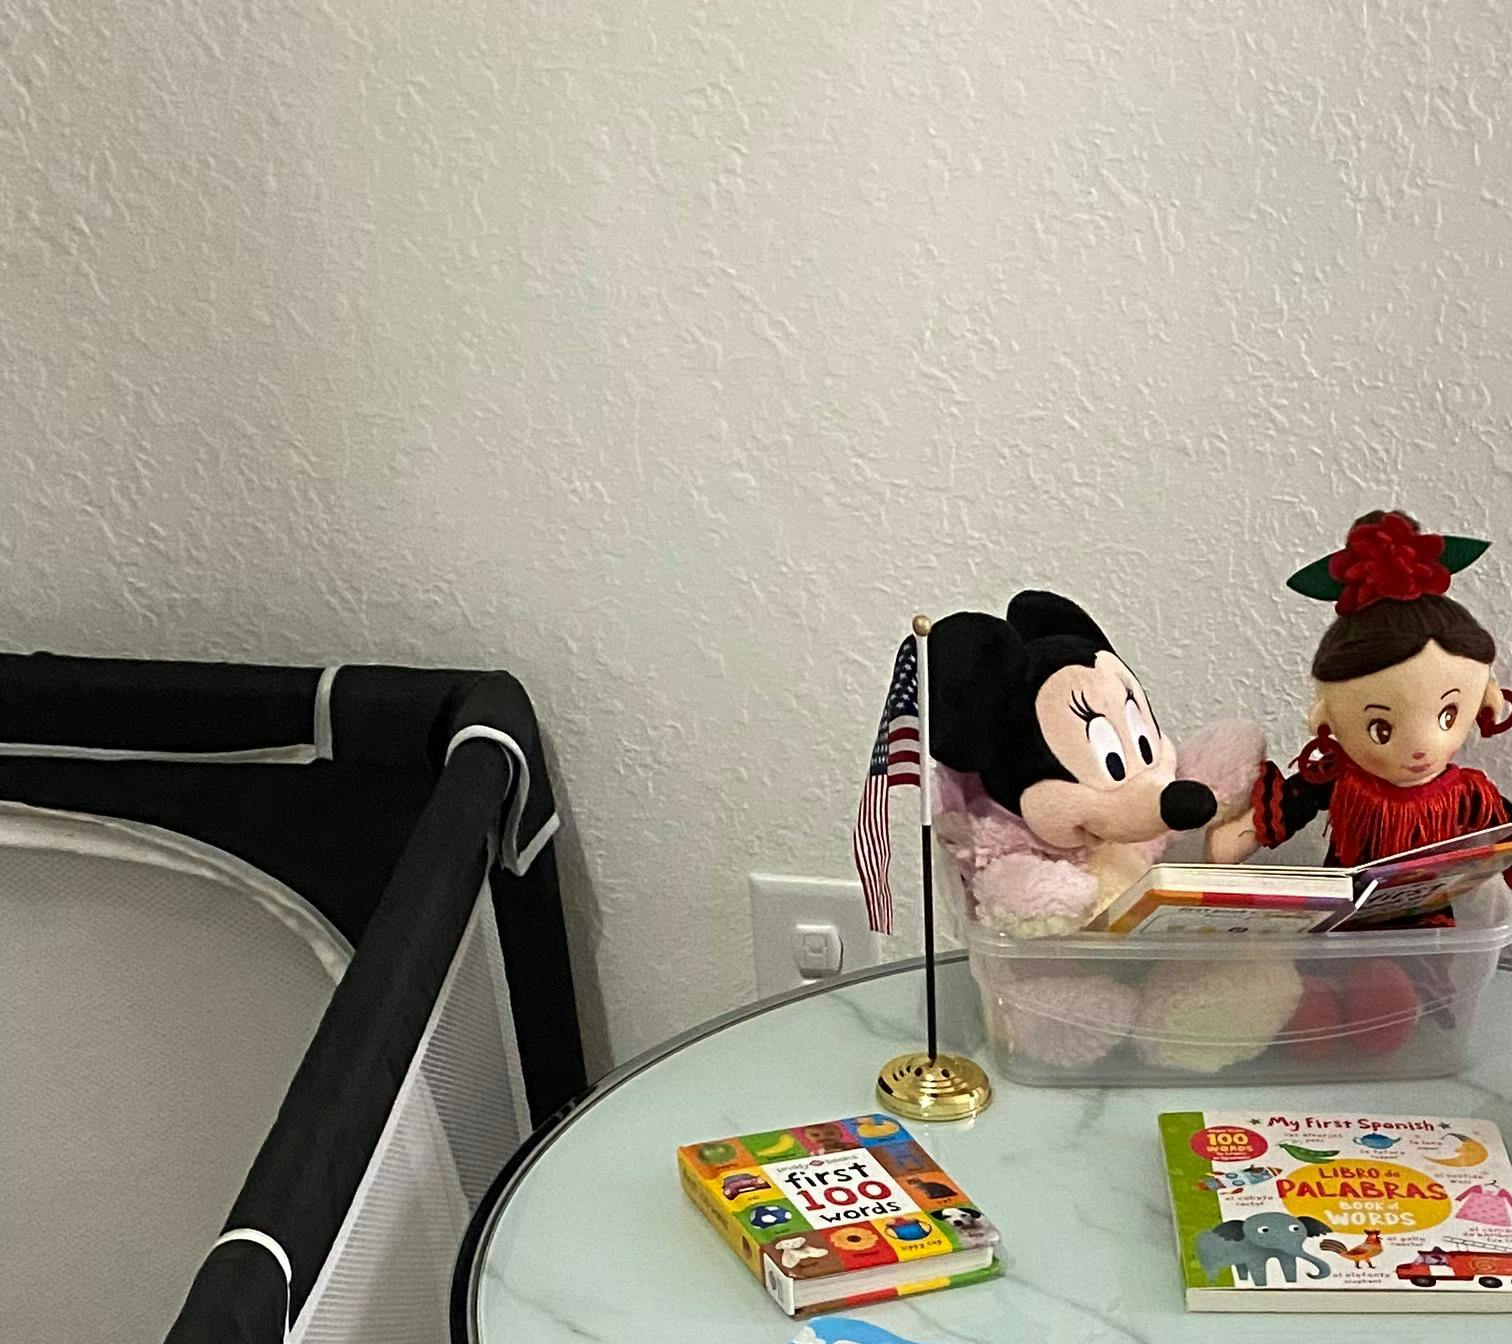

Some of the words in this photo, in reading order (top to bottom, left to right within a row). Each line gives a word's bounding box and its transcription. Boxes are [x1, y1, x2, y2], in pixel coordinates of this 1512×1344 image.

[1267, 1116, 1300, 1132] My
[1305, 1117, 1352, 1129] First
[1359, 1118, 1435, 1132] Spanish
[1207, 1133, 1249, 1146] 100
[785, 1162, 870, 1190] first
[1318, 1166, 1381, 1180] LIBRO
[797, 1180, 892, 1211] 100
[1276, 1179, 1449, 1202] PALABRAS
[819, 1200, 902, 1223] words
[1339, 1200, 1388, 1211] BOOK
[1326, 1209, 1416, 1226] WORDS
